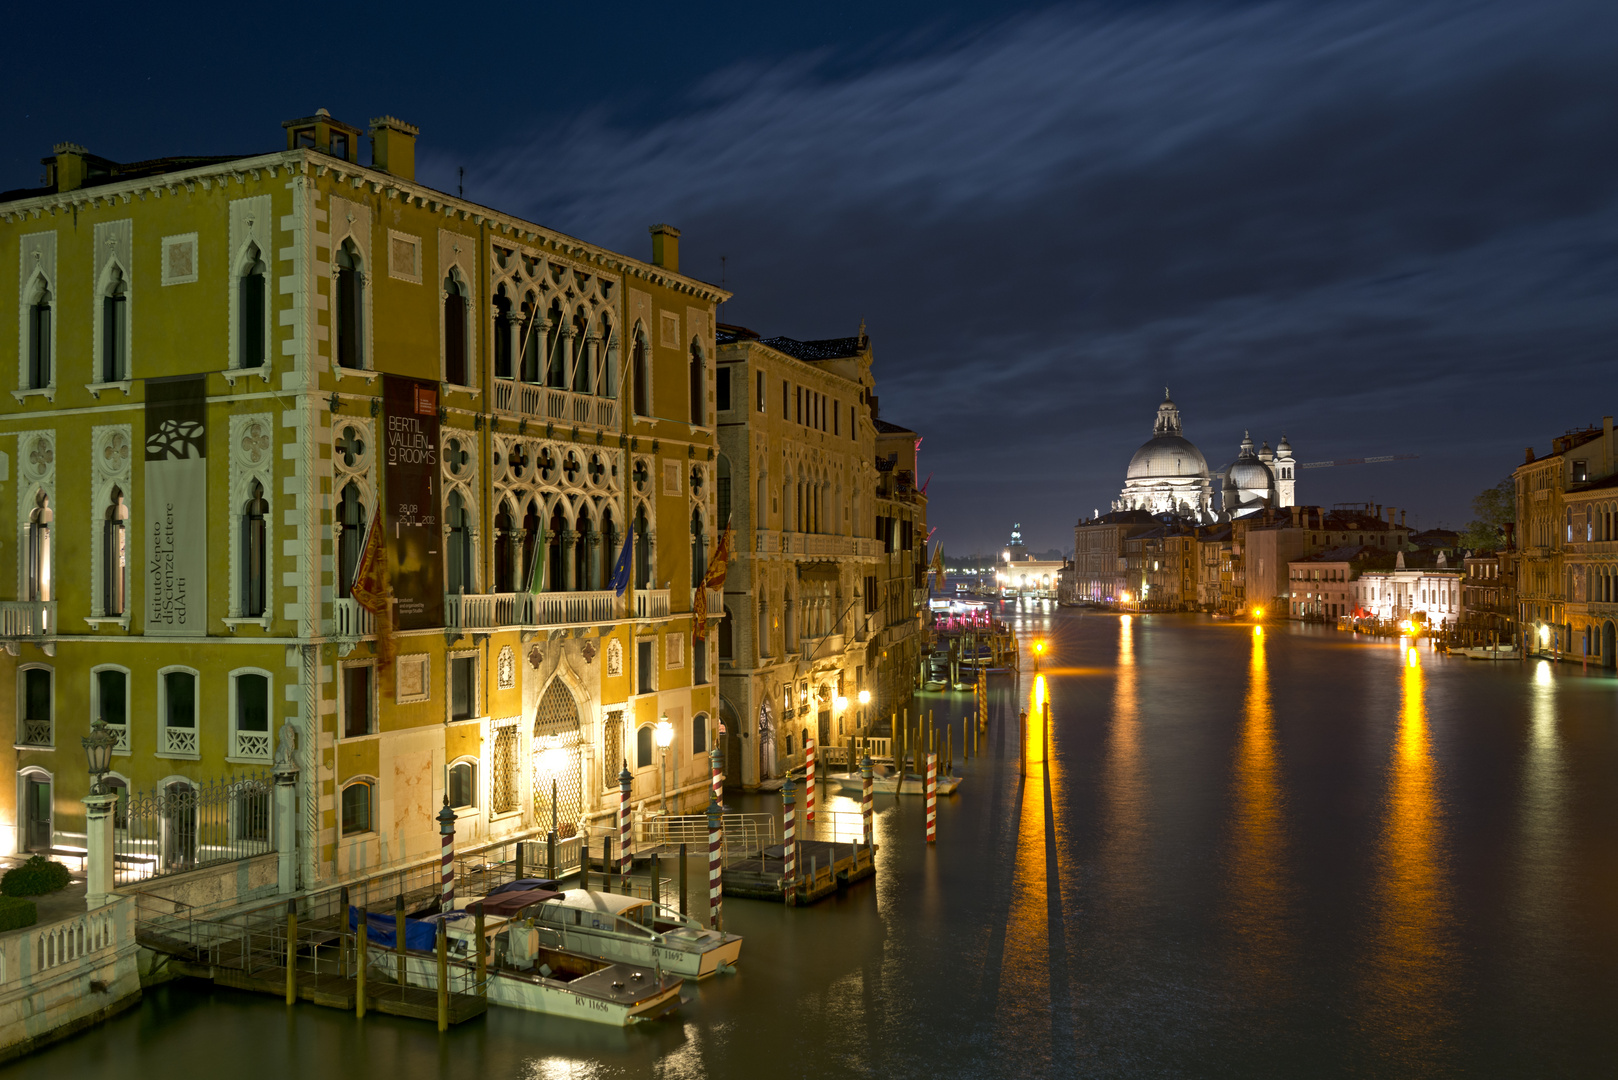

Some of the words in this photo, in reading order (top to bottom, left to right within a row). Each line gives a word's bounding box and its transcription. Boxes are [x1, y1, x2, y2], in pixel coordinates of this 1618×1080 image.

[389, 416, 423, 434] BERTIL
[388, 447, 397, 462] 9
[399, 447, 436, 465] ROOMS
[651, 947, 662, 957] RV
[665, 949, 684, 962] 11692
[575, 996, 586, 1006] RV
[589, 999, 609, 1012] 11656
